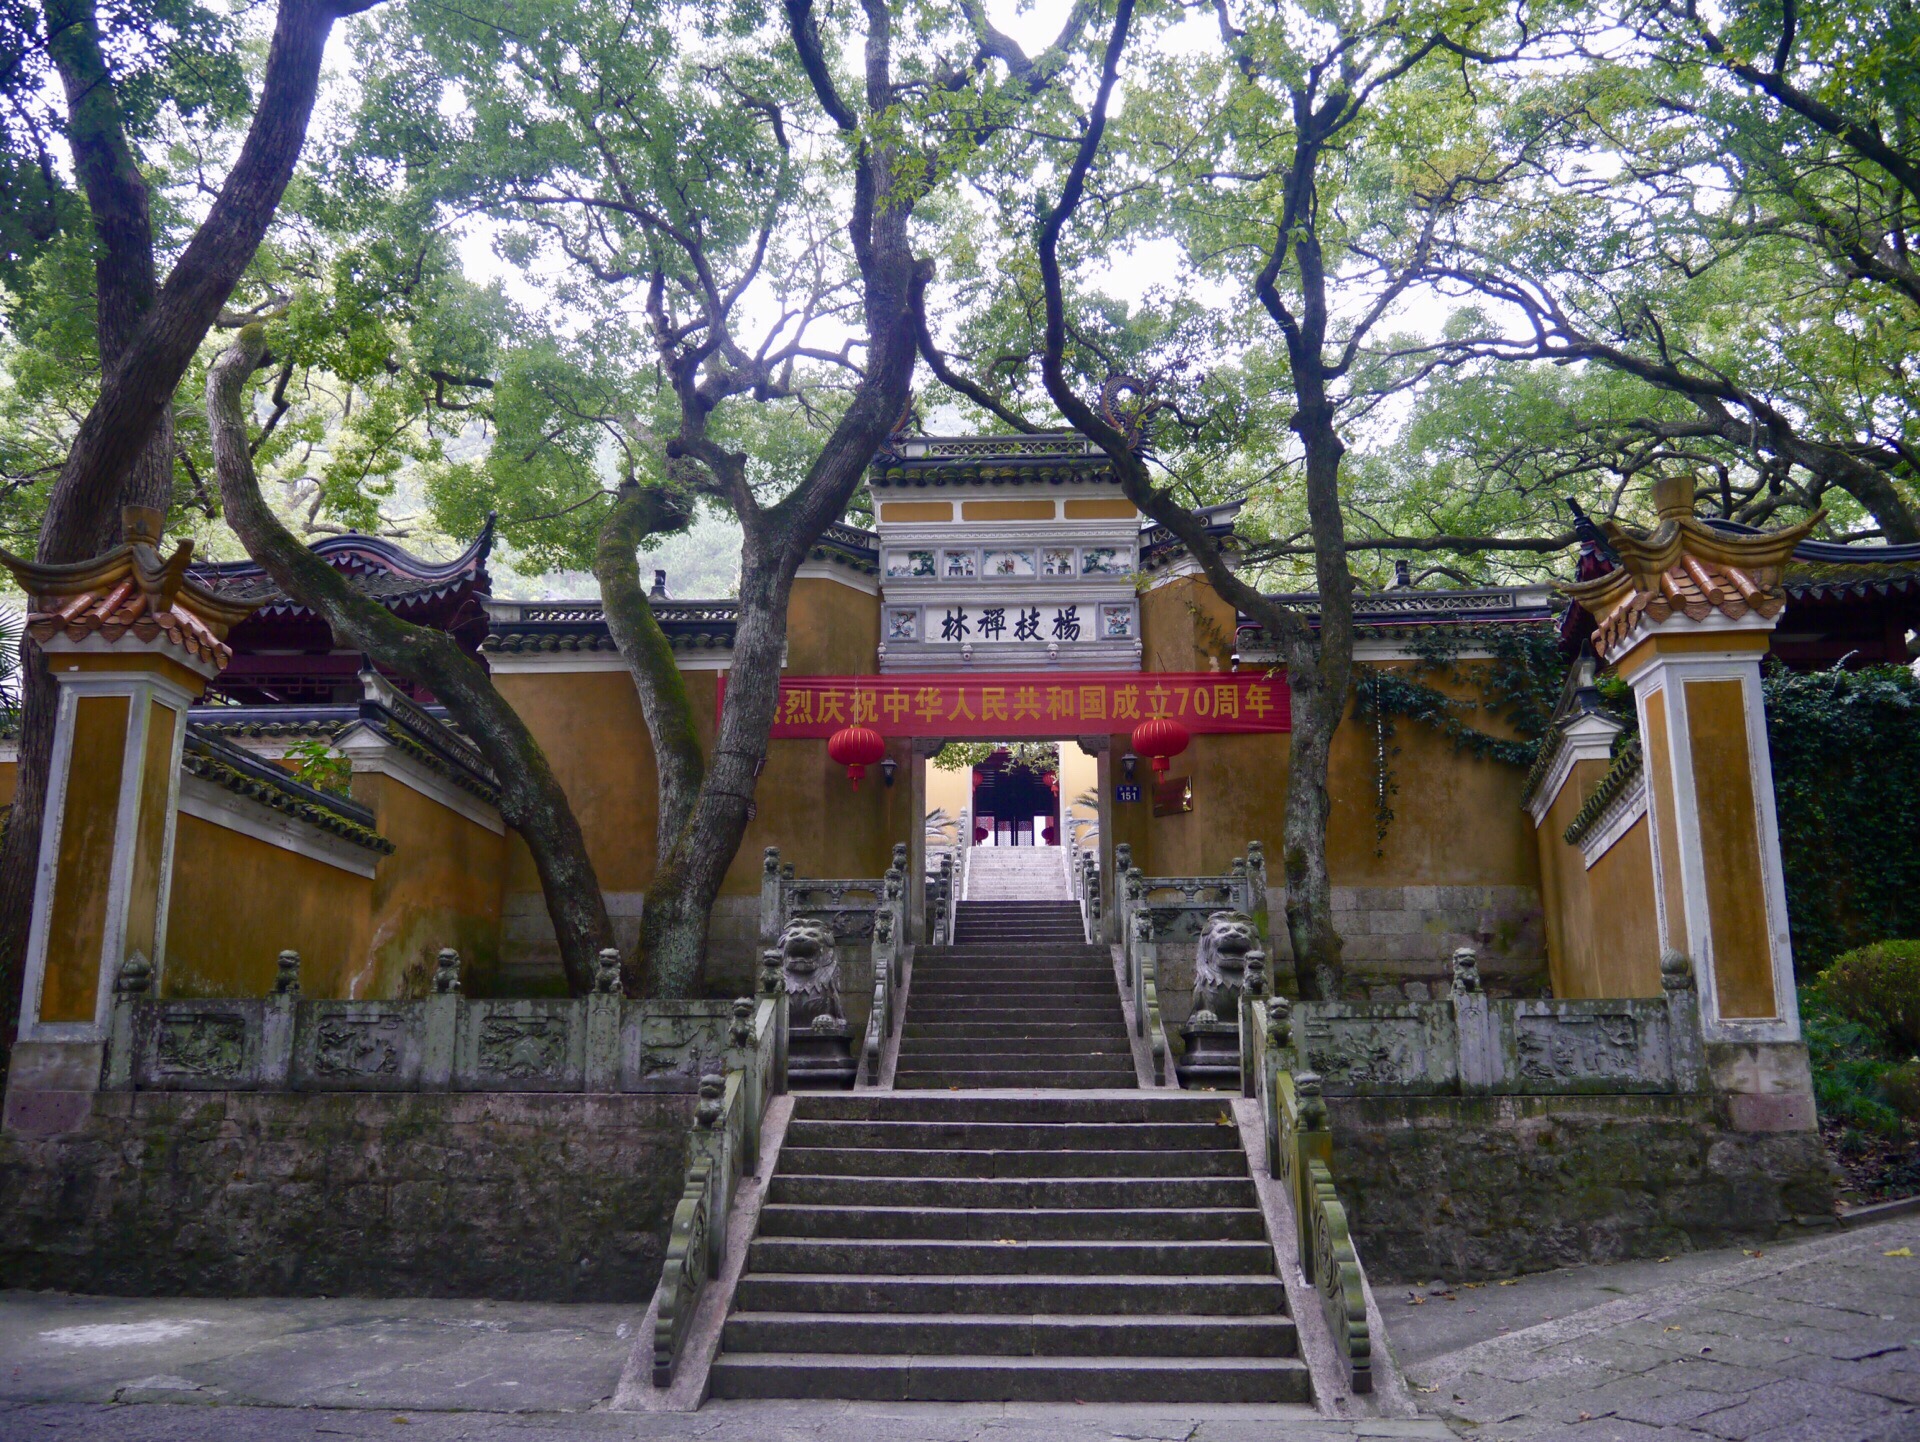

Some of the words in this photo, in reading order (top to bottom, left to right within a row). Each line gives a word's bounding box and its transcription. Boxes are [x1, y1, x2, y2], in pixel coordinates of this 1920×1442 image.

[774, 683, 1274, 725] 烈庆祝中华人民共和国成立70周年
[1120, 791, 1136, 801] 151
